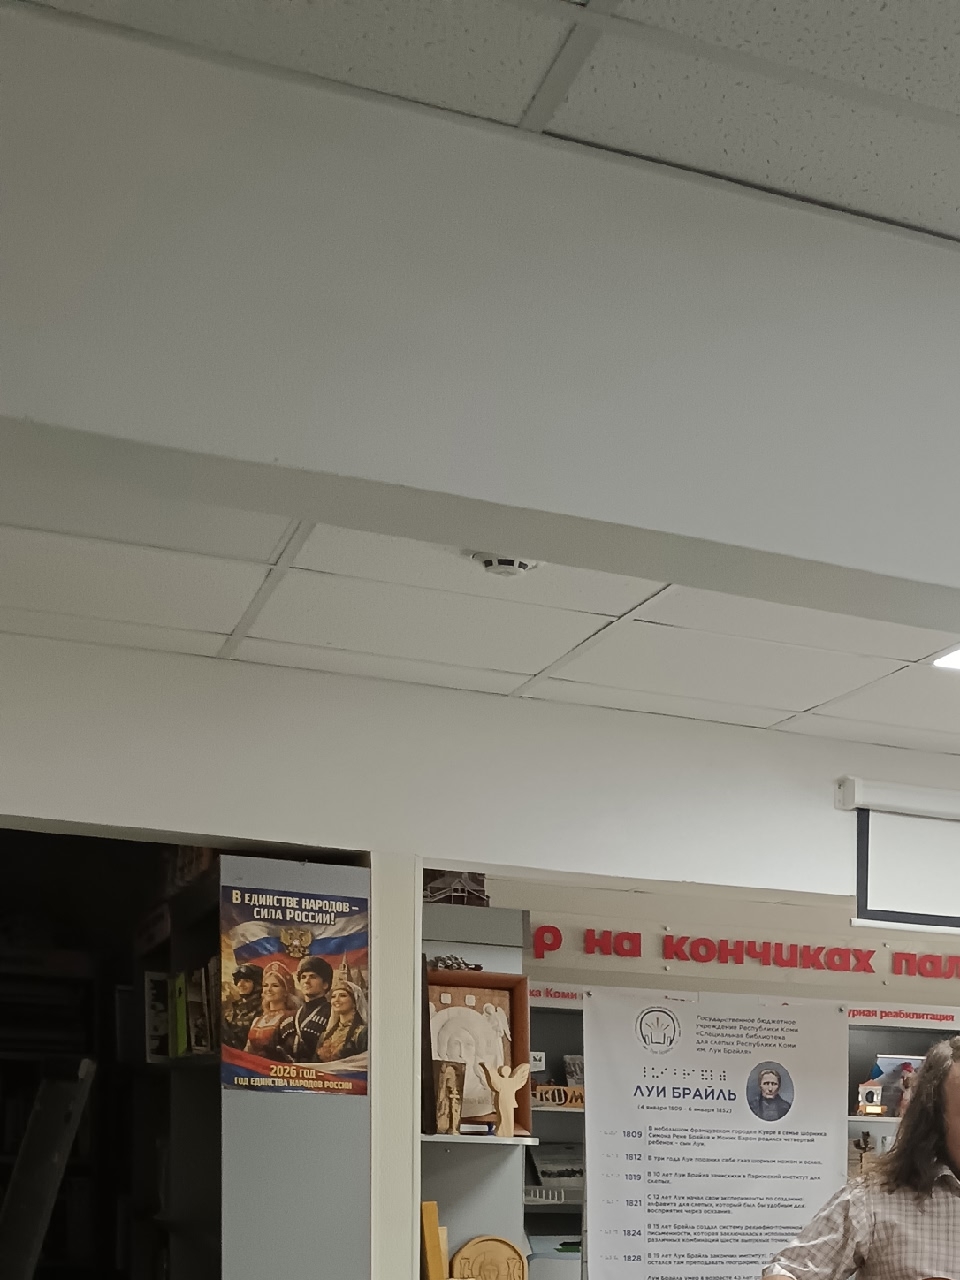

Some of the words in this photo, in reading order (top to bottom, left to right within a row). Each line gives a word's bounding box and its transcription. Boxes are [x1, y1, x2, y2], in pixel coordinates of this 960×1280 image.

[232, 889, 241, 904] В
[244, 893, 299, 908] ЕДИНСТВЕ
[302, 898, 350, 913] НАРОДОВ
[253, 907, 283, 920] СИЛА
[286, 908, 335, 925] РОССИИ!
[584, 928, 642, 957] на
[662, 934, 876, 973] кончиках
[545, 987, 577, 999] Коми
[880, 1010, 955, 1022] реабилитация
[270, 1065, 297, 1077] 2026
[633, 1085, 667, 1098] ЛУИ
[672, 1085, 737, 1102] БРАЙЛЬ
[622, 1130, 643, 1138] 1809
[625, 1153, 642, 1161] 1812
[625, 1199, 642, 1207] 1821
[622, 1229, 642, 1237] 1824
[623, 1254, 642, 1262] 1828
